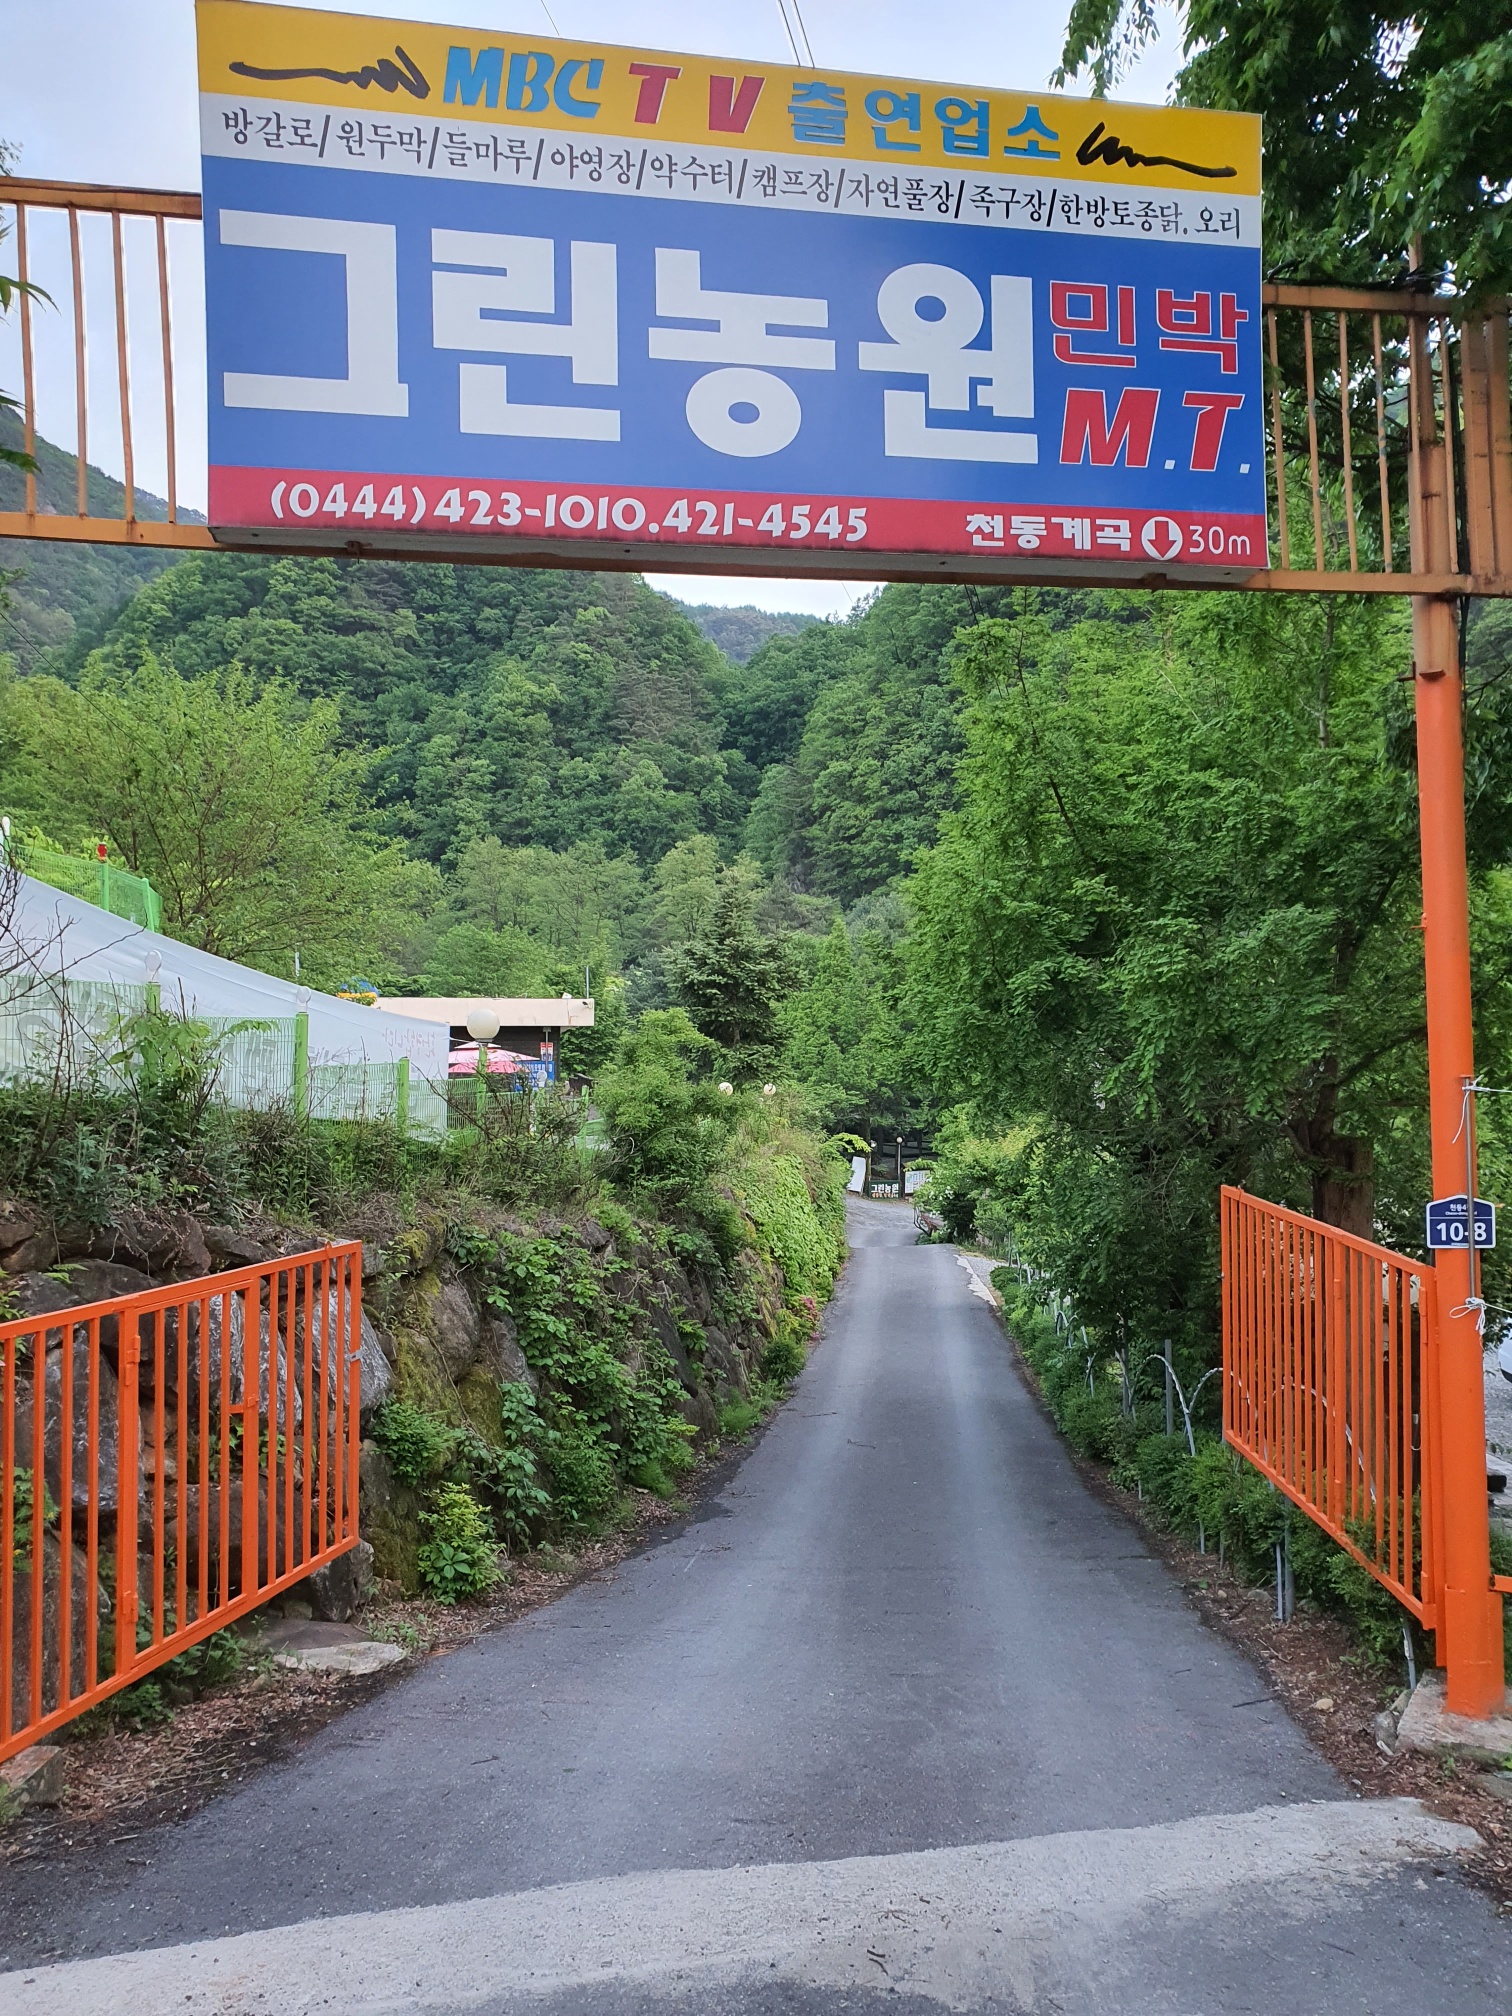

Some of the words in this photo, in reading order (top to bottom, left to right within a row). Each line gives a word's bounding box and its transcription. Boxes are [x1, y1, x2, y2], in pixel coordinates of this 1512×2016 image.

[442, 45, 605, 119] MBC
[787, 80, 1062, 161] 출연업소
[219, 208, 1039, 465] 그린농원
[1049, 279, 1249, 376] 민박
[965, 513, 1132, 553] 천동계곡
[1188, 524, 1252, 556] 30m
[871, 1183, 899, 1193] 그린농원
[1436, 1222, 1487, 1241] 10-8
